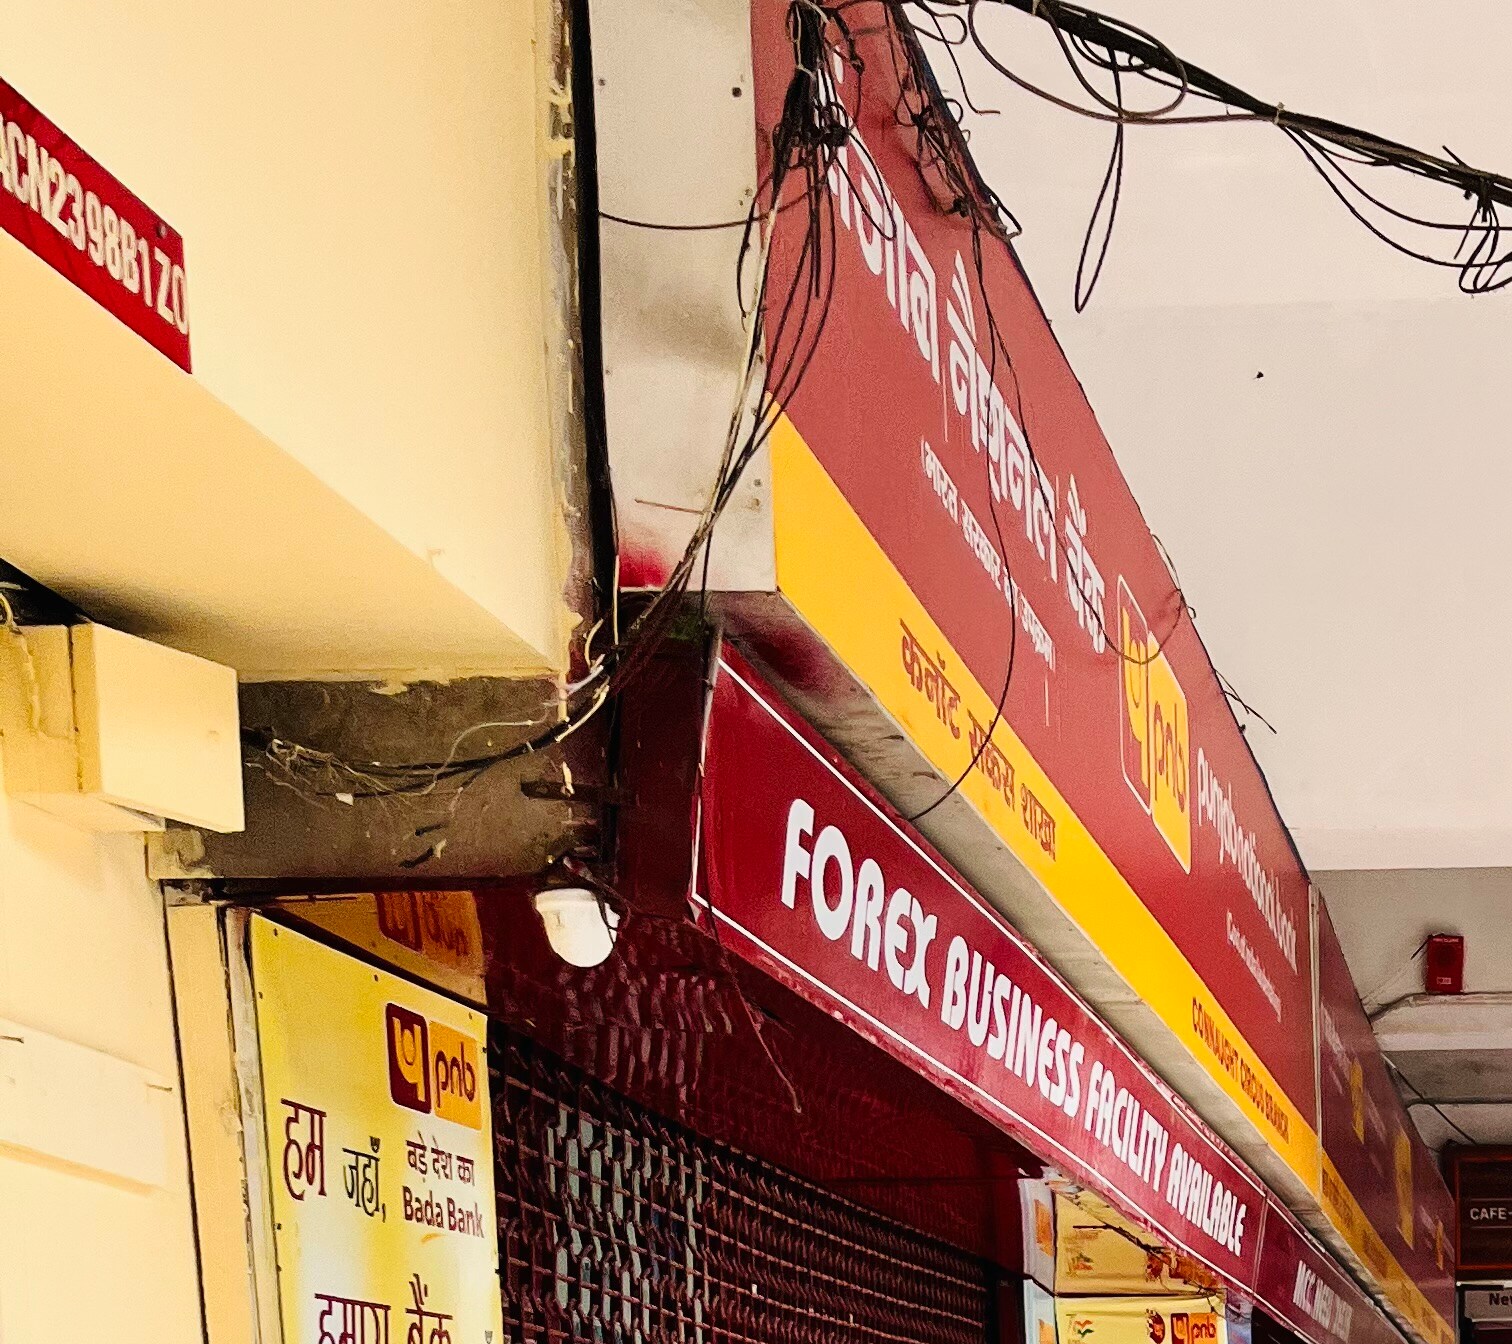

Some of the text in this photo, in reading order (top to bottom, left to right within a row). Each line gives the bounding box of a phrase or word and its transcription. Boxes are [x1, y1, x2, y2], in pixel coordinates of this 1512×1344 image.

[1065, 473, 1106, 654] बैंक
[1154, 699, 1187, 814] pnb
[1020, 783, 1056, 862] शाखा
[781, 798, 938, 1009] FOREX
[940, 935, 1084, 1118] BUSINESS
[1084, 1061, 1169, 1193] FACILITY
[1166, 1143, 1247, 1257] AVAILABLE
[435, 1041, 475, 1109] pnb
[281, 1098, 327, 1201] हम
[405, 1130, 476, 1188] बड़े देश का
[401, 1186, 486, 1239] Bada Bank
